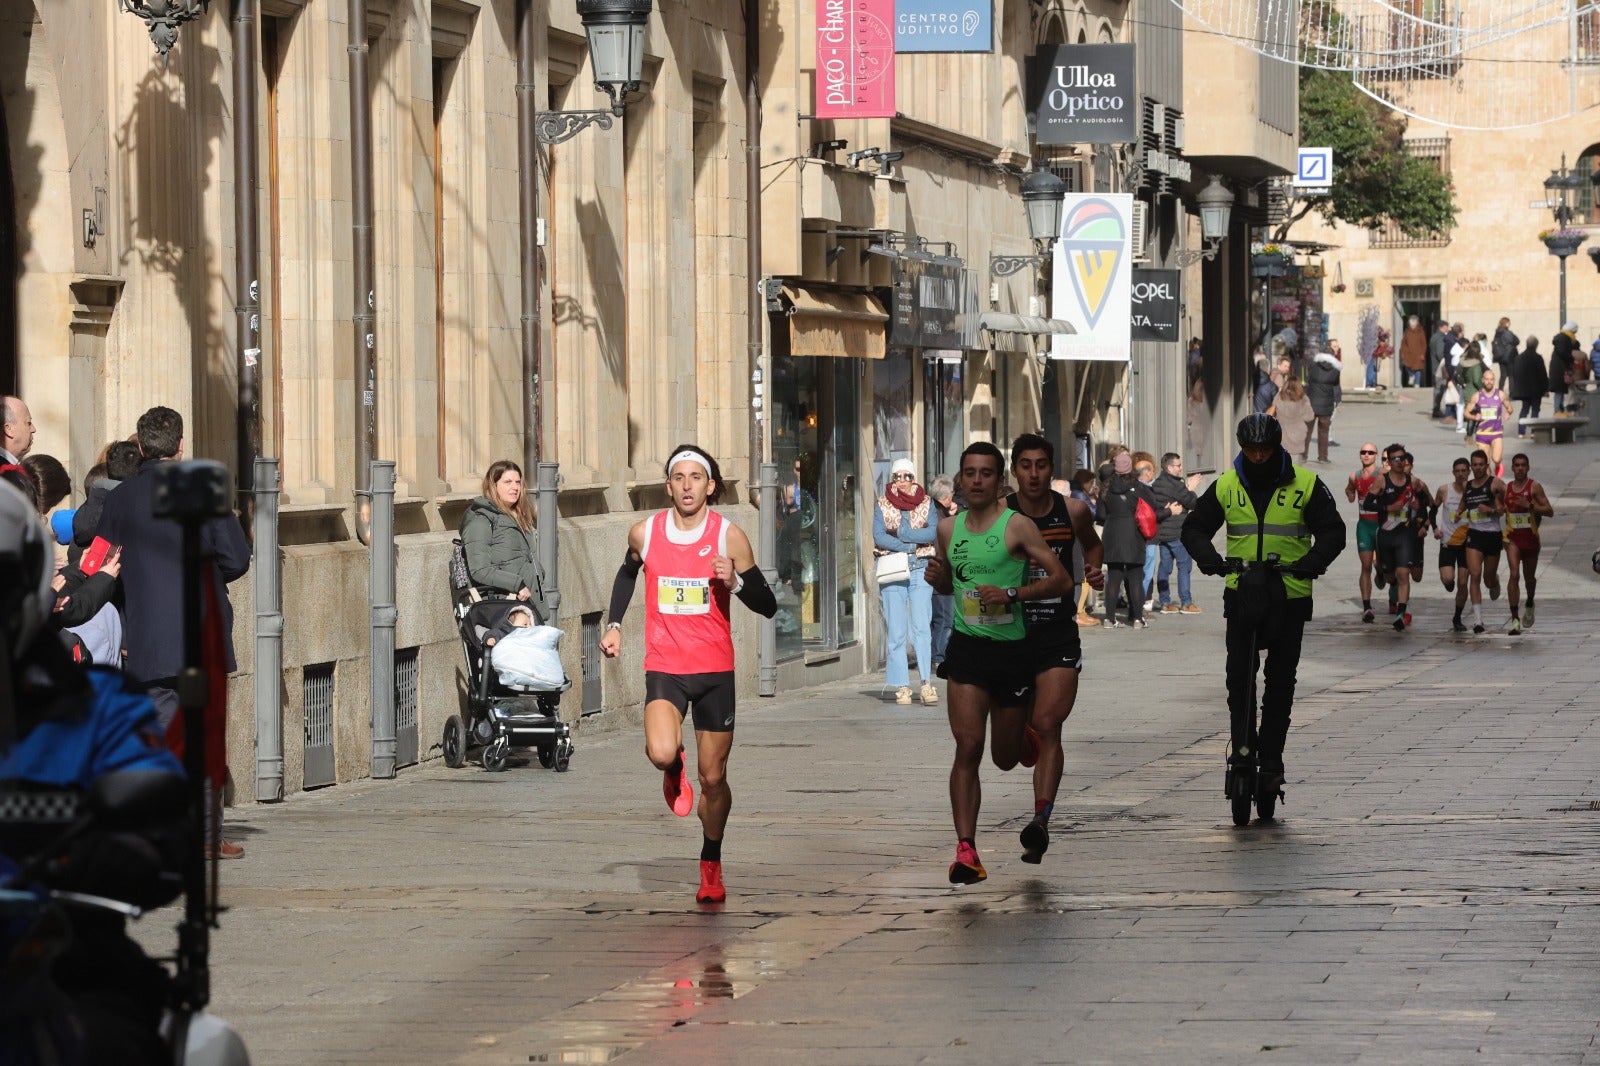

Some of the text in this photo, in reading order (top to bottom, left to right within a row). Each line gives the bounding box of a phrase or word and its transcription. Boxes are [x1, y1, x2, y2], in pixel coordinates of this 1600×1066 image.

[899, 13, 958, 23] CENTRO
[1054, 65, 1117, 88] Ulloa
[1048, 88, 1124, 117] Optico
[676, 588, 684, 602] 3
